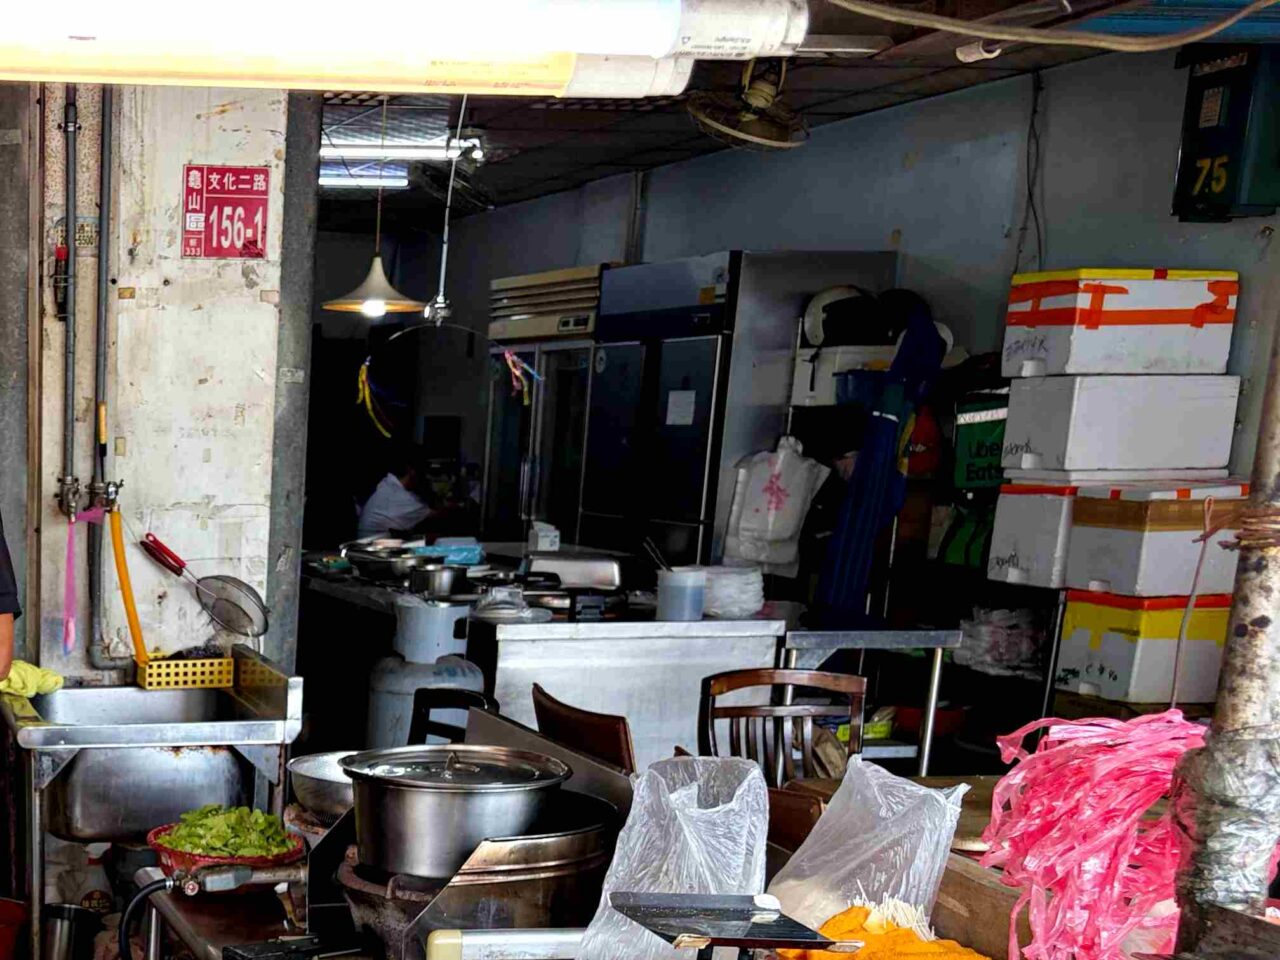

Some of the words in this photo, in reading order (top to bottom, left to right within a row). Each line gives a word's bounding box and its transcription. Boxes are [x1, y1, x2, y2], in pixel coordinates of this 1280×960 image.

[208, 172, 267, 191] 文化二路
[187, 170, 205, 231] 龜山區
[209, 205, 263, 249] 156-1
[185, 247, 201, 256] 333
